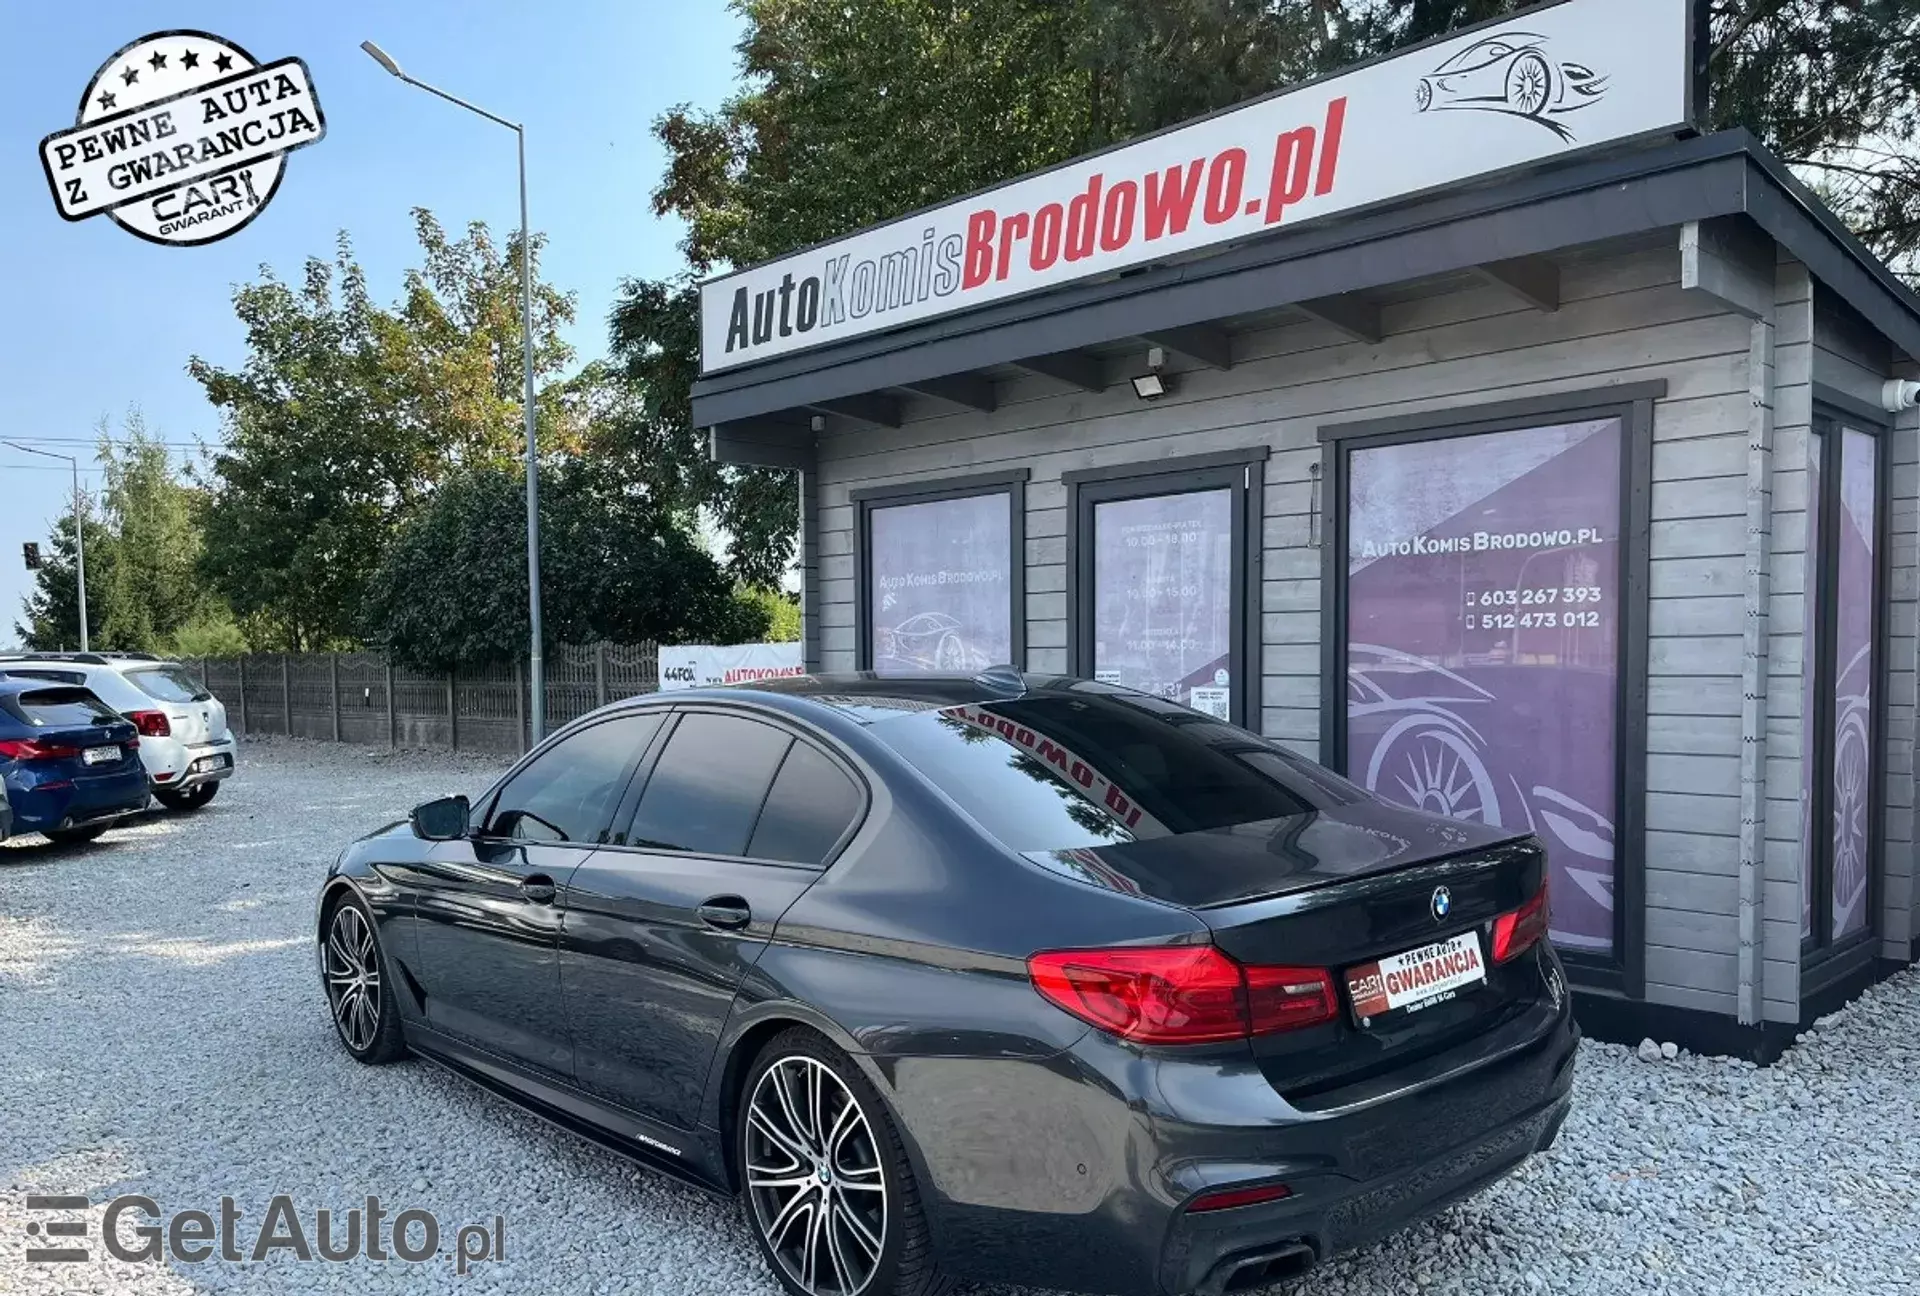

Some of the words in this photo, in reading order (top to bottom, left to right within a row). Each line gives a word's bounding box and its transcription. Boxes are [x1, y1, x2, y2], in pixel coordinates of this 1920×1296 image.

[724, 96, 1348, 353] AutoKomisBrodowo.pl
[1480, 589, 1518, 606] 603
[1521, 588, 1558, 605] 267
[1562, 587, 1602, 603] 393
[1481, 614, 1515, 629] 512
[1520, 613, 1557, 629] 473
[1563, 611, 1600, 628] 012
[1385, 947, 1480, 995] GWARANCJA
